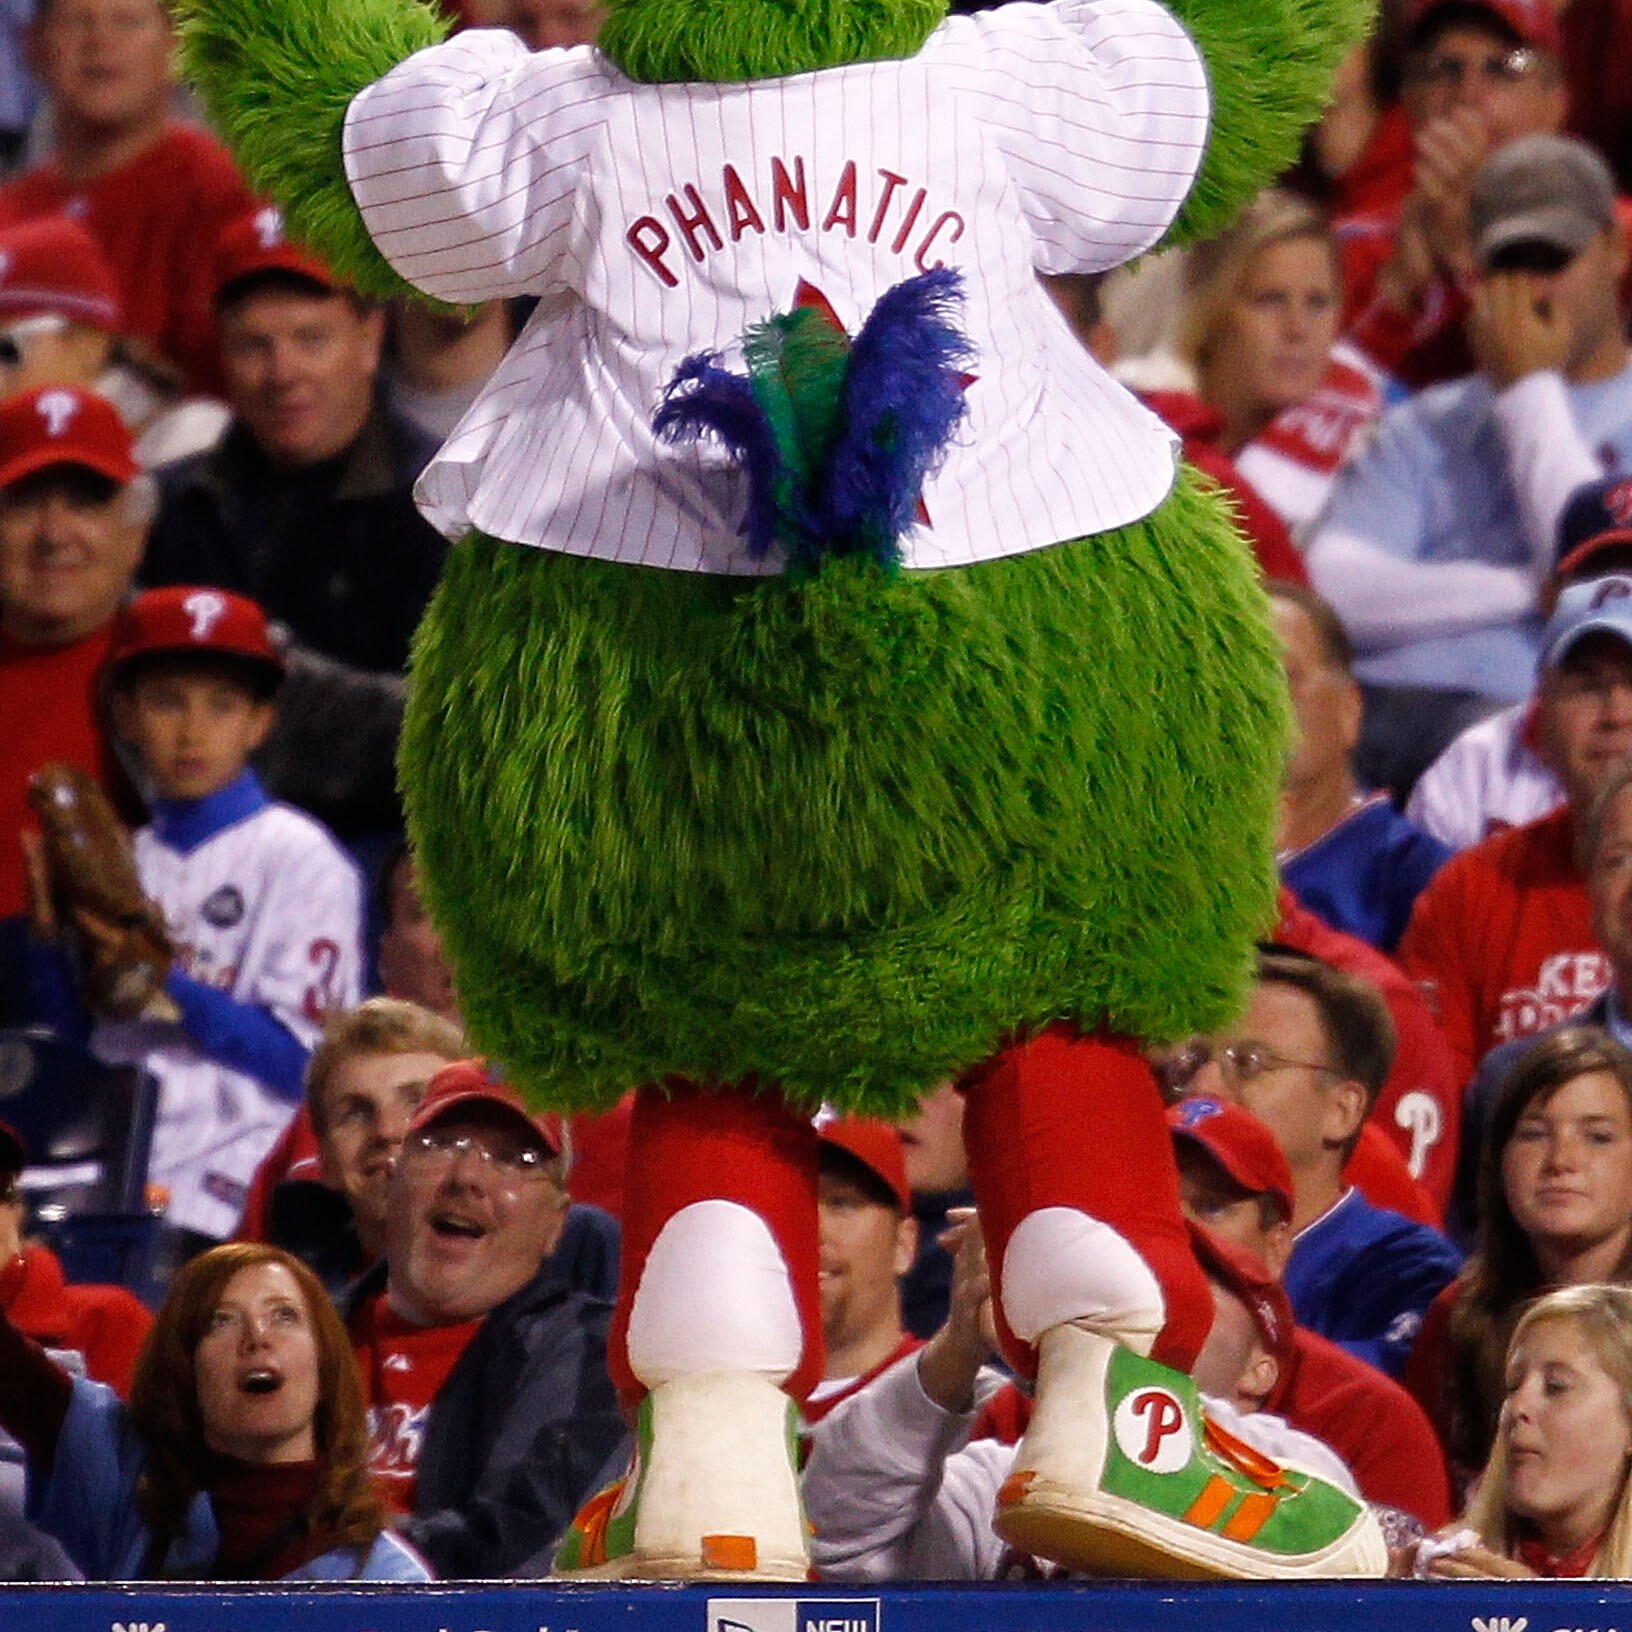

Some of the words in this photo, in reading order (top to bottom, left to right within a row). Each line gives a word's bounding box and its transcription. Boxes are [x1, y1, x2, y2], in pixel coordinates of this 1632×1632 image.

[626, 154, 967, 289] PHANATIC
[1394, 1091, 1442, 1181] P
[1132, 1391, 1182, 1464] P
